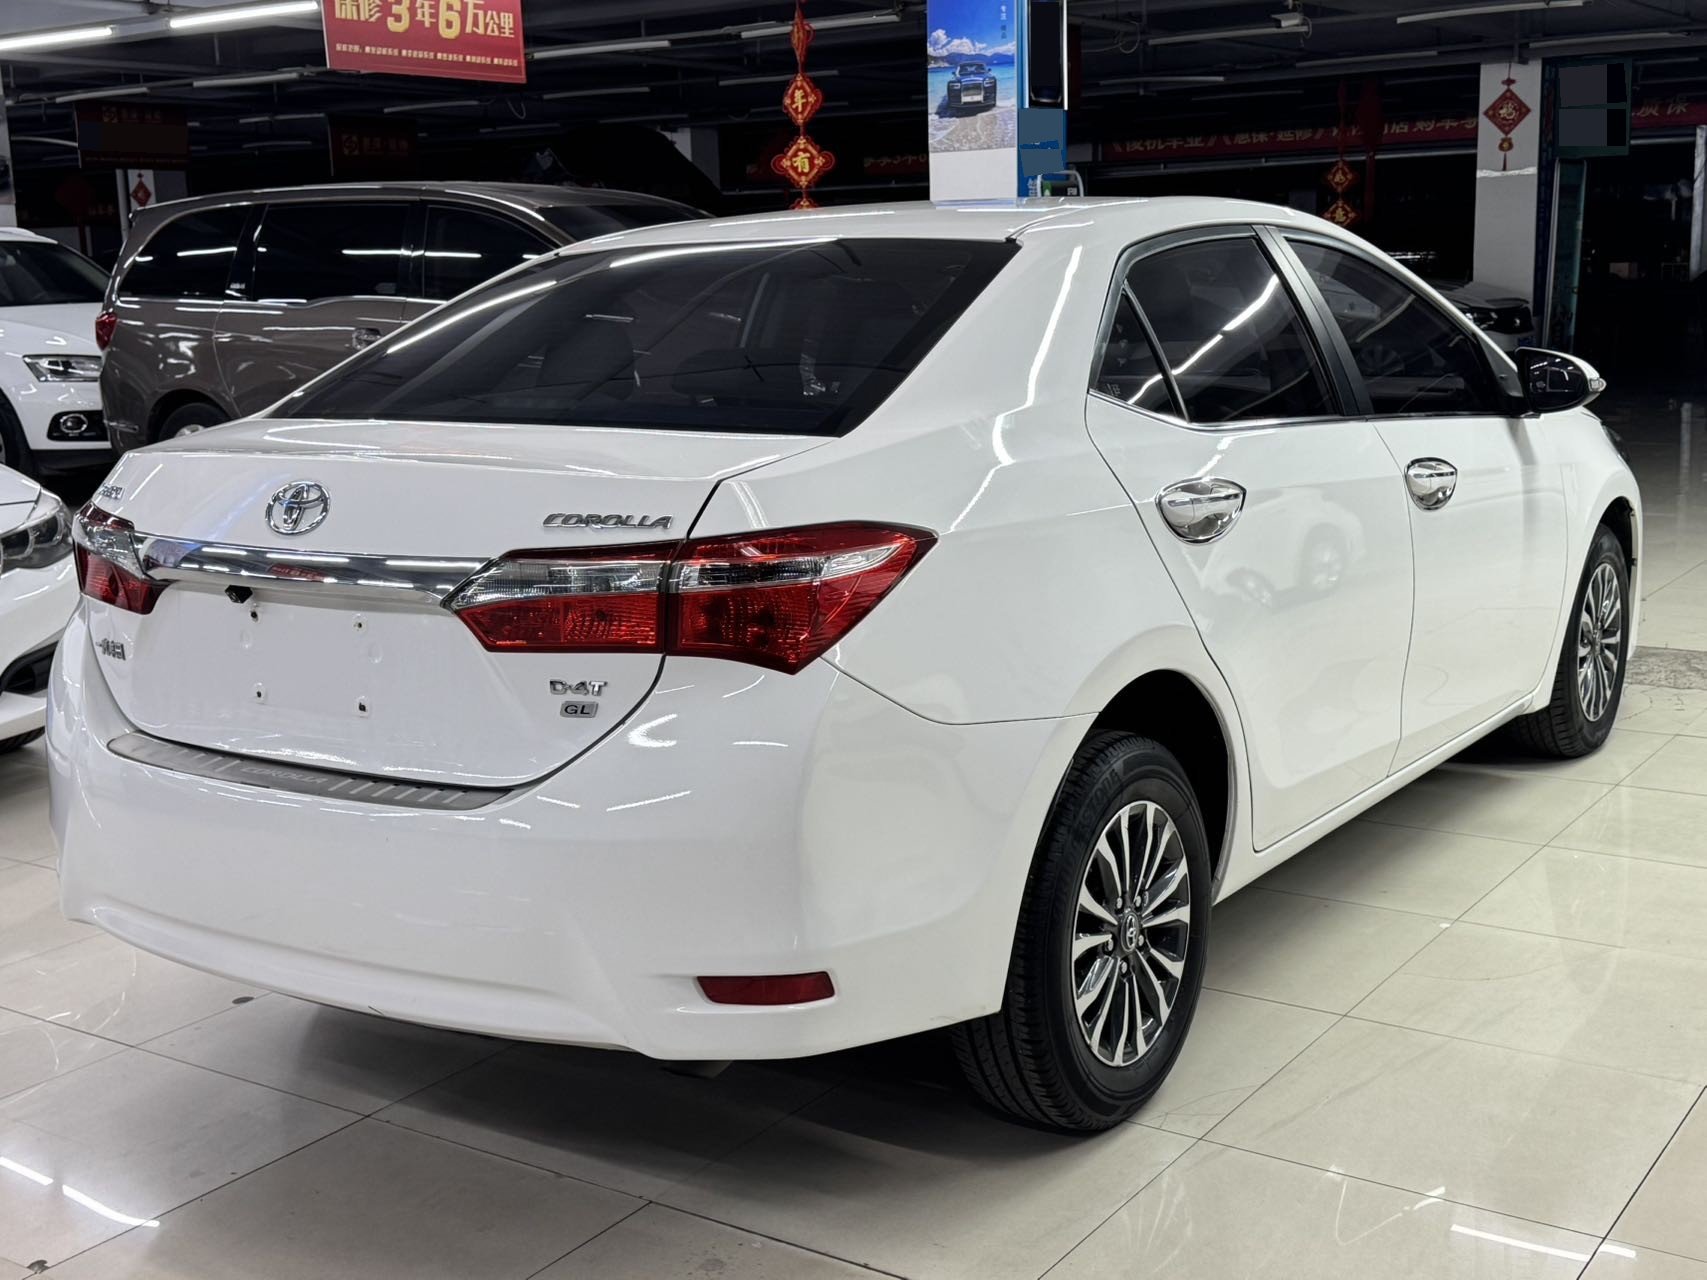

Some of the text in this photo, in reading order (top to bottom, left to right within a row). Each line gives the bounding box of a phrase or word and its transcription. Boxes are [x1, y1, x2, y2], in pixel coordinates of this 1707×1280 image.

[792, 89, 807, 112] 年
[792, 151, 811, 173] 有
[543, 513, 674, 530] COROLLA
[564, 703, 591, 715] GL
[240, 767, 329, 784] COROLLA
